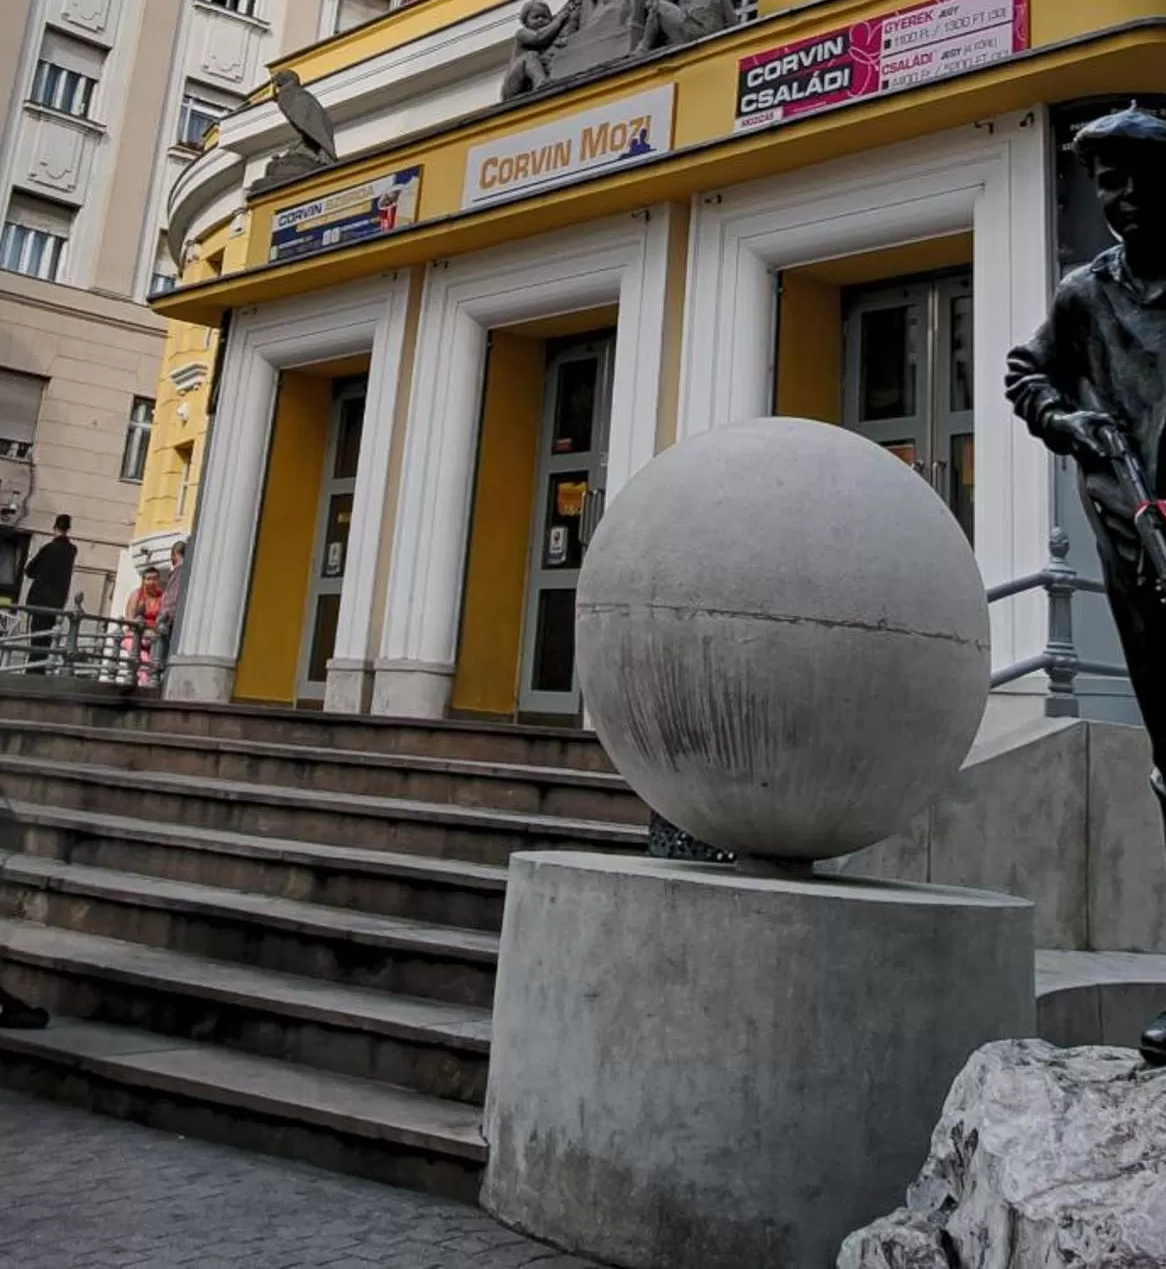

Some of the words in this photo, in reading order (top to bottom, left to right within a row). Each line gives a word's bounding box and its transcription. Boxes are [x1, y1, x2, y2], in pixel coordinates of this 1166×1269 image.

[884, 9, 934, 34] GYEREK
[746, 35, 844, 89] CORVIN
[882, 51, 934, 76] CSALÁDI
[740, 67, 851, 113] CSALÁDI
[478, 137, 572, 190] CORVIN
[277, 202, 323, 227] CORVIN
